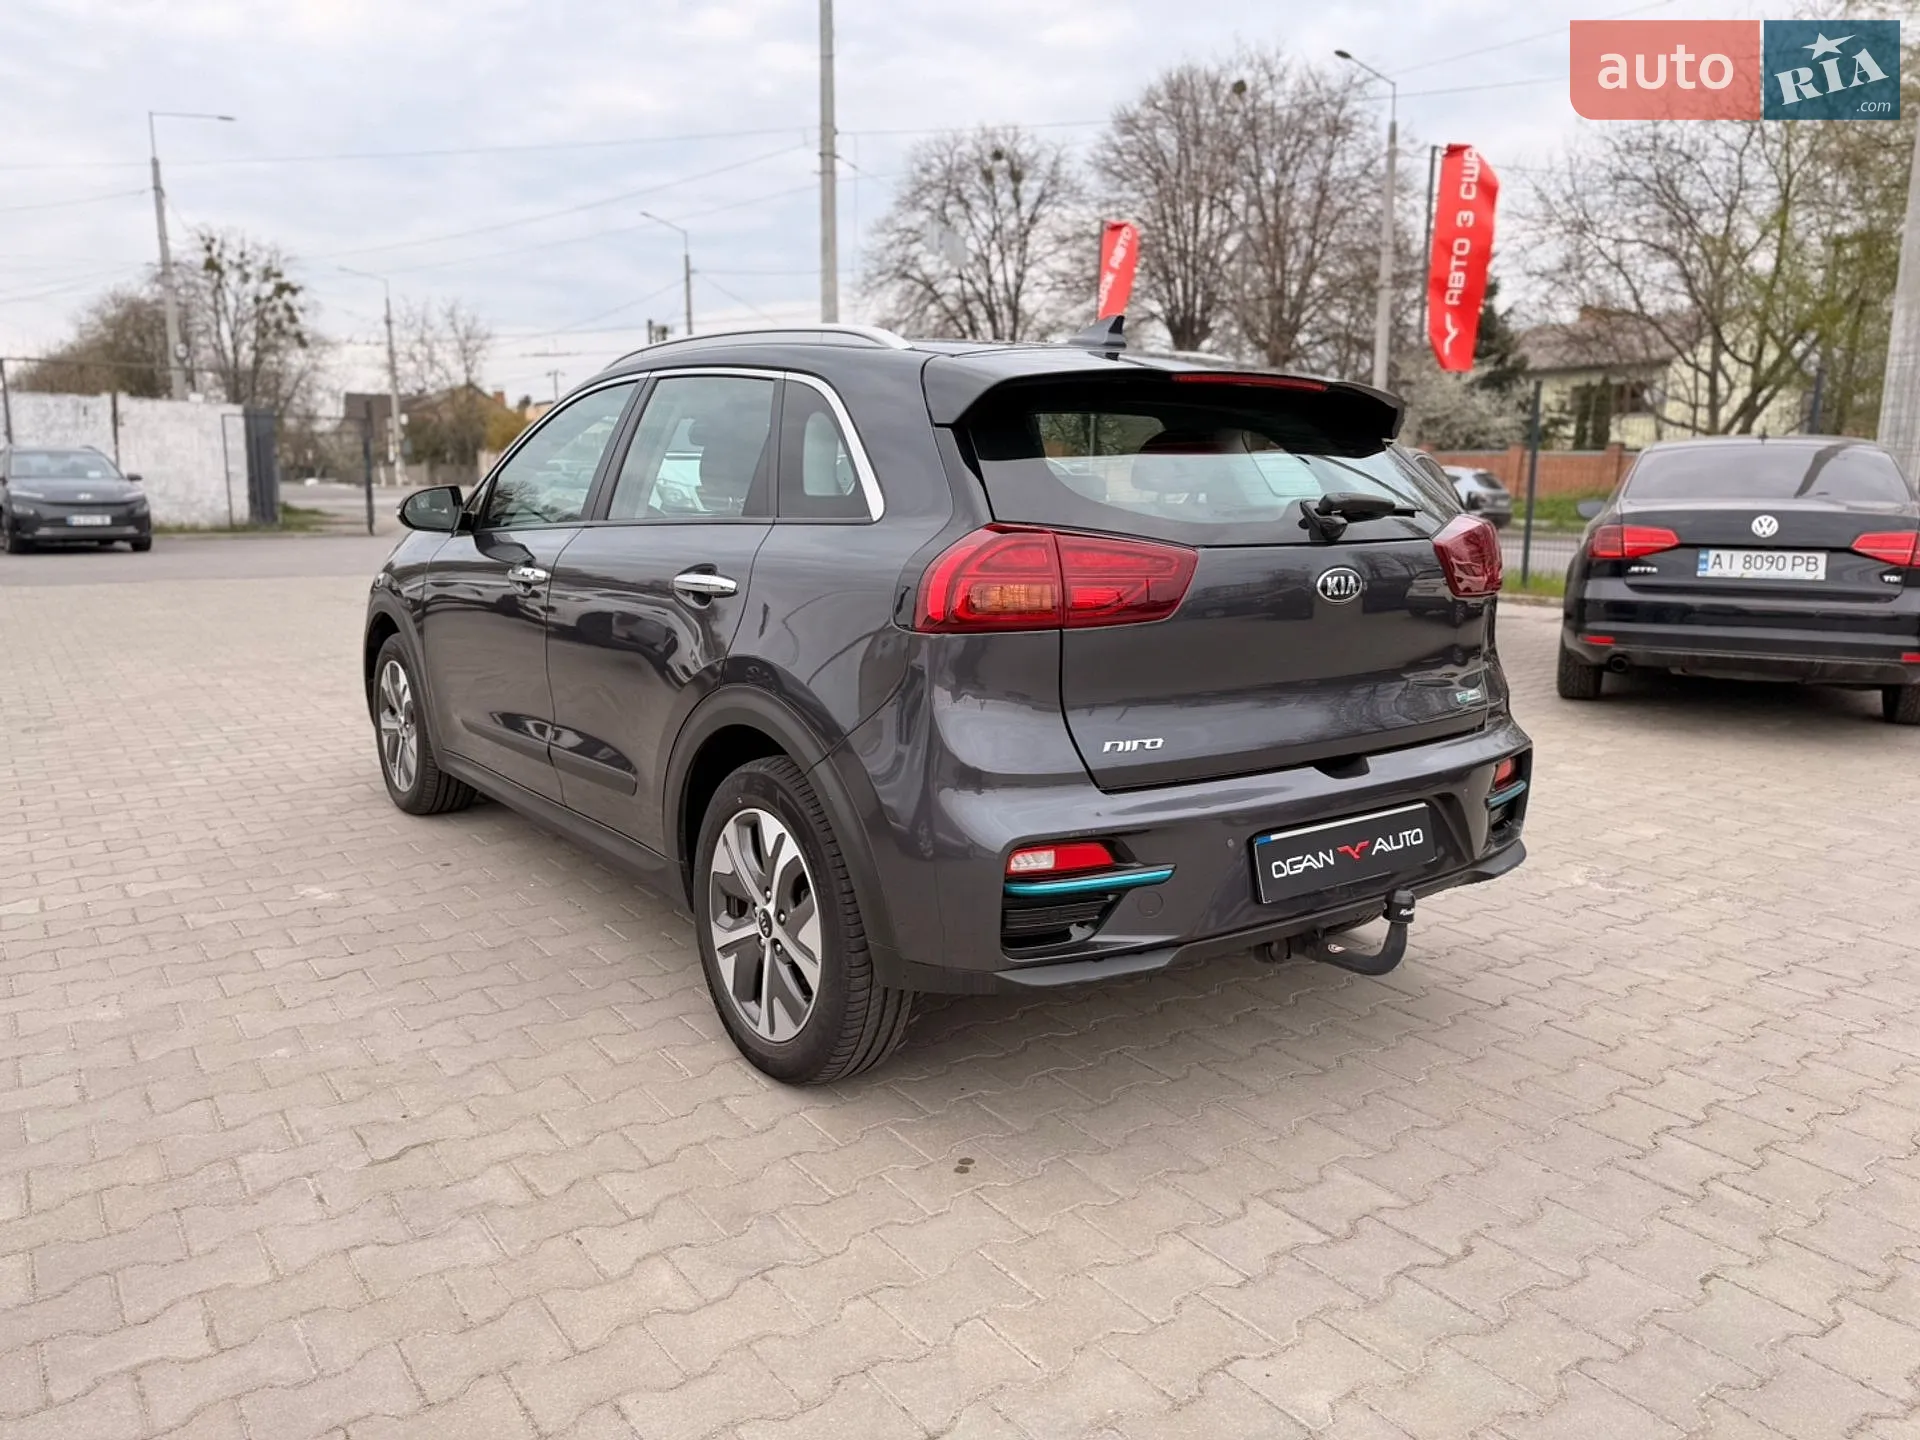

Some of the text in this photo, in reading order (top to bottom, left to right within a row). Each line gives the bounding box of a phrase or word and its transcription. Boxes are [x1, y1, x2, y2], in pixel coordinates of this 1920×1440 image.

[1742, 554, 1787, 571] 8090
[1791, 555, 1819, 572] PB
[1326, 575, 1357, 596] KIA
[1271, 827, 1424, 879] OGAN AUTO
